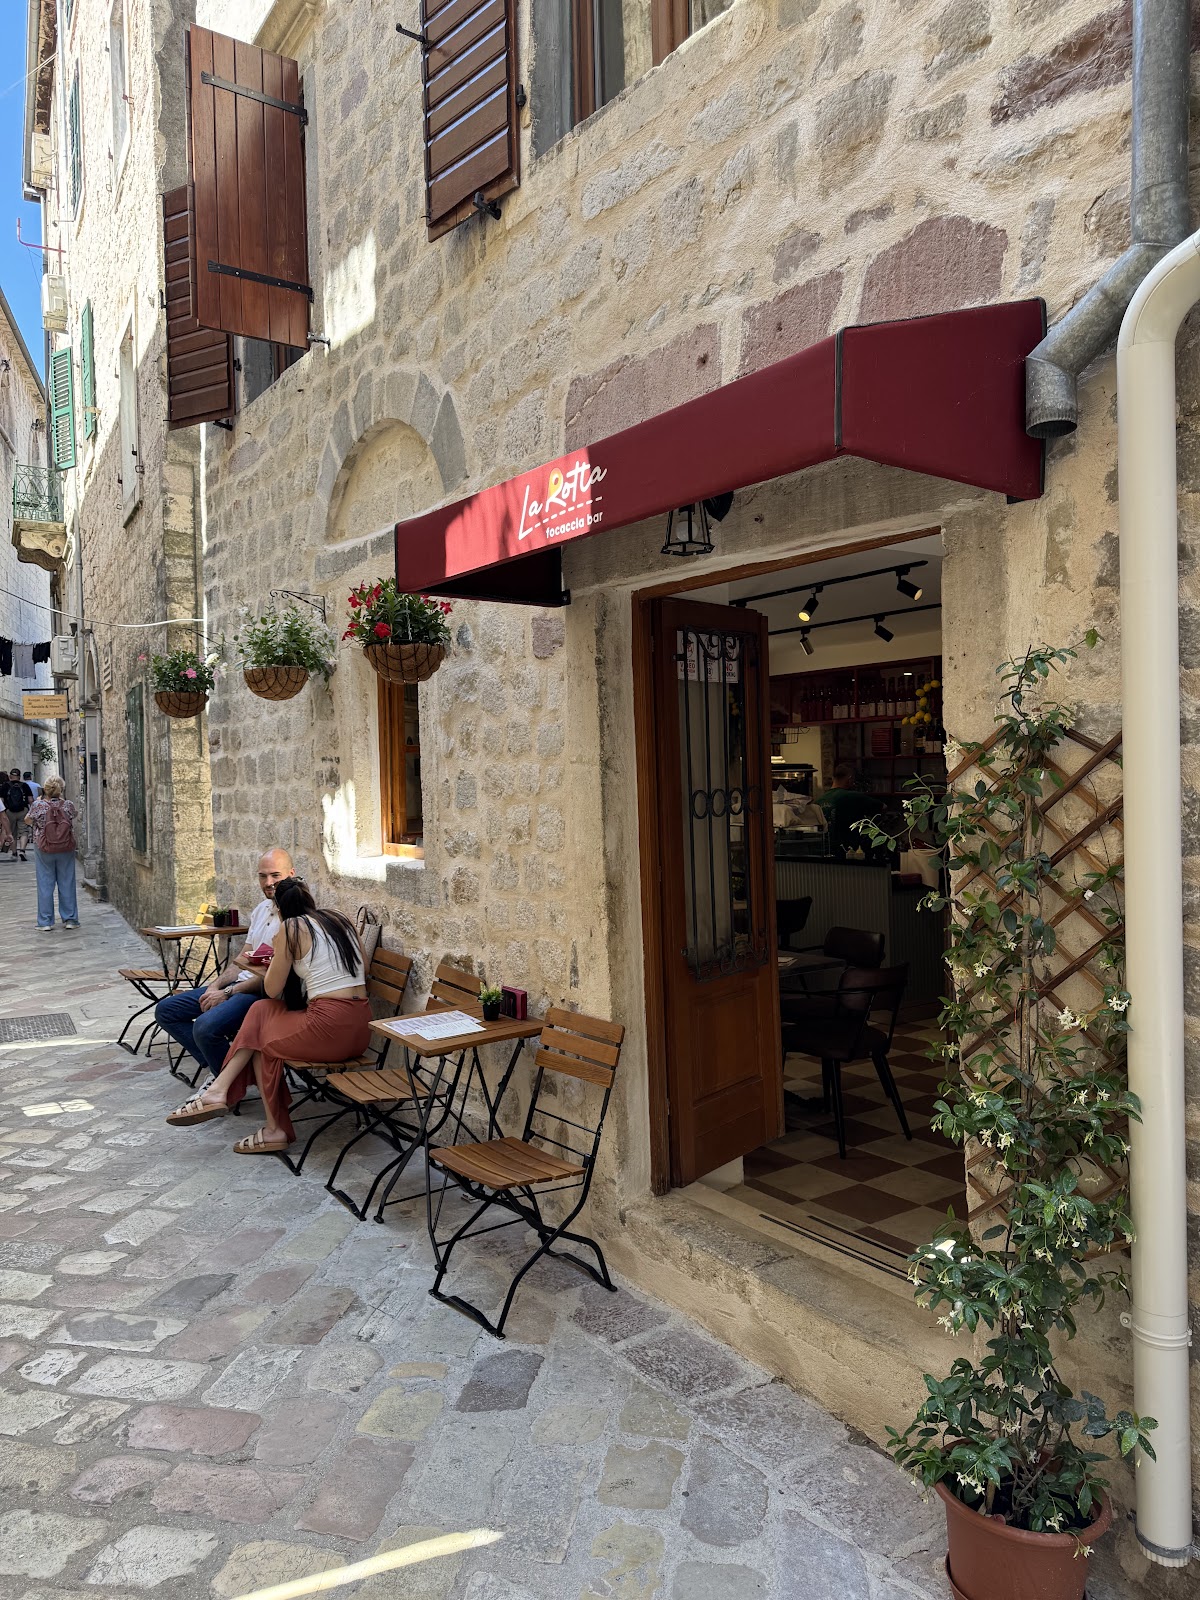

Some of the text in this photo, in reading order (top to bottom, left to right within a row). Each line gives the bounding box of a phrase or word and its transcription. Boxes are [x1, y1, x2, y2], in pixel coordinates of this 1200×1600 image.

[518, 461, 607, 540] La Rotta
[546, 512, 603, 538] focaccia bar
